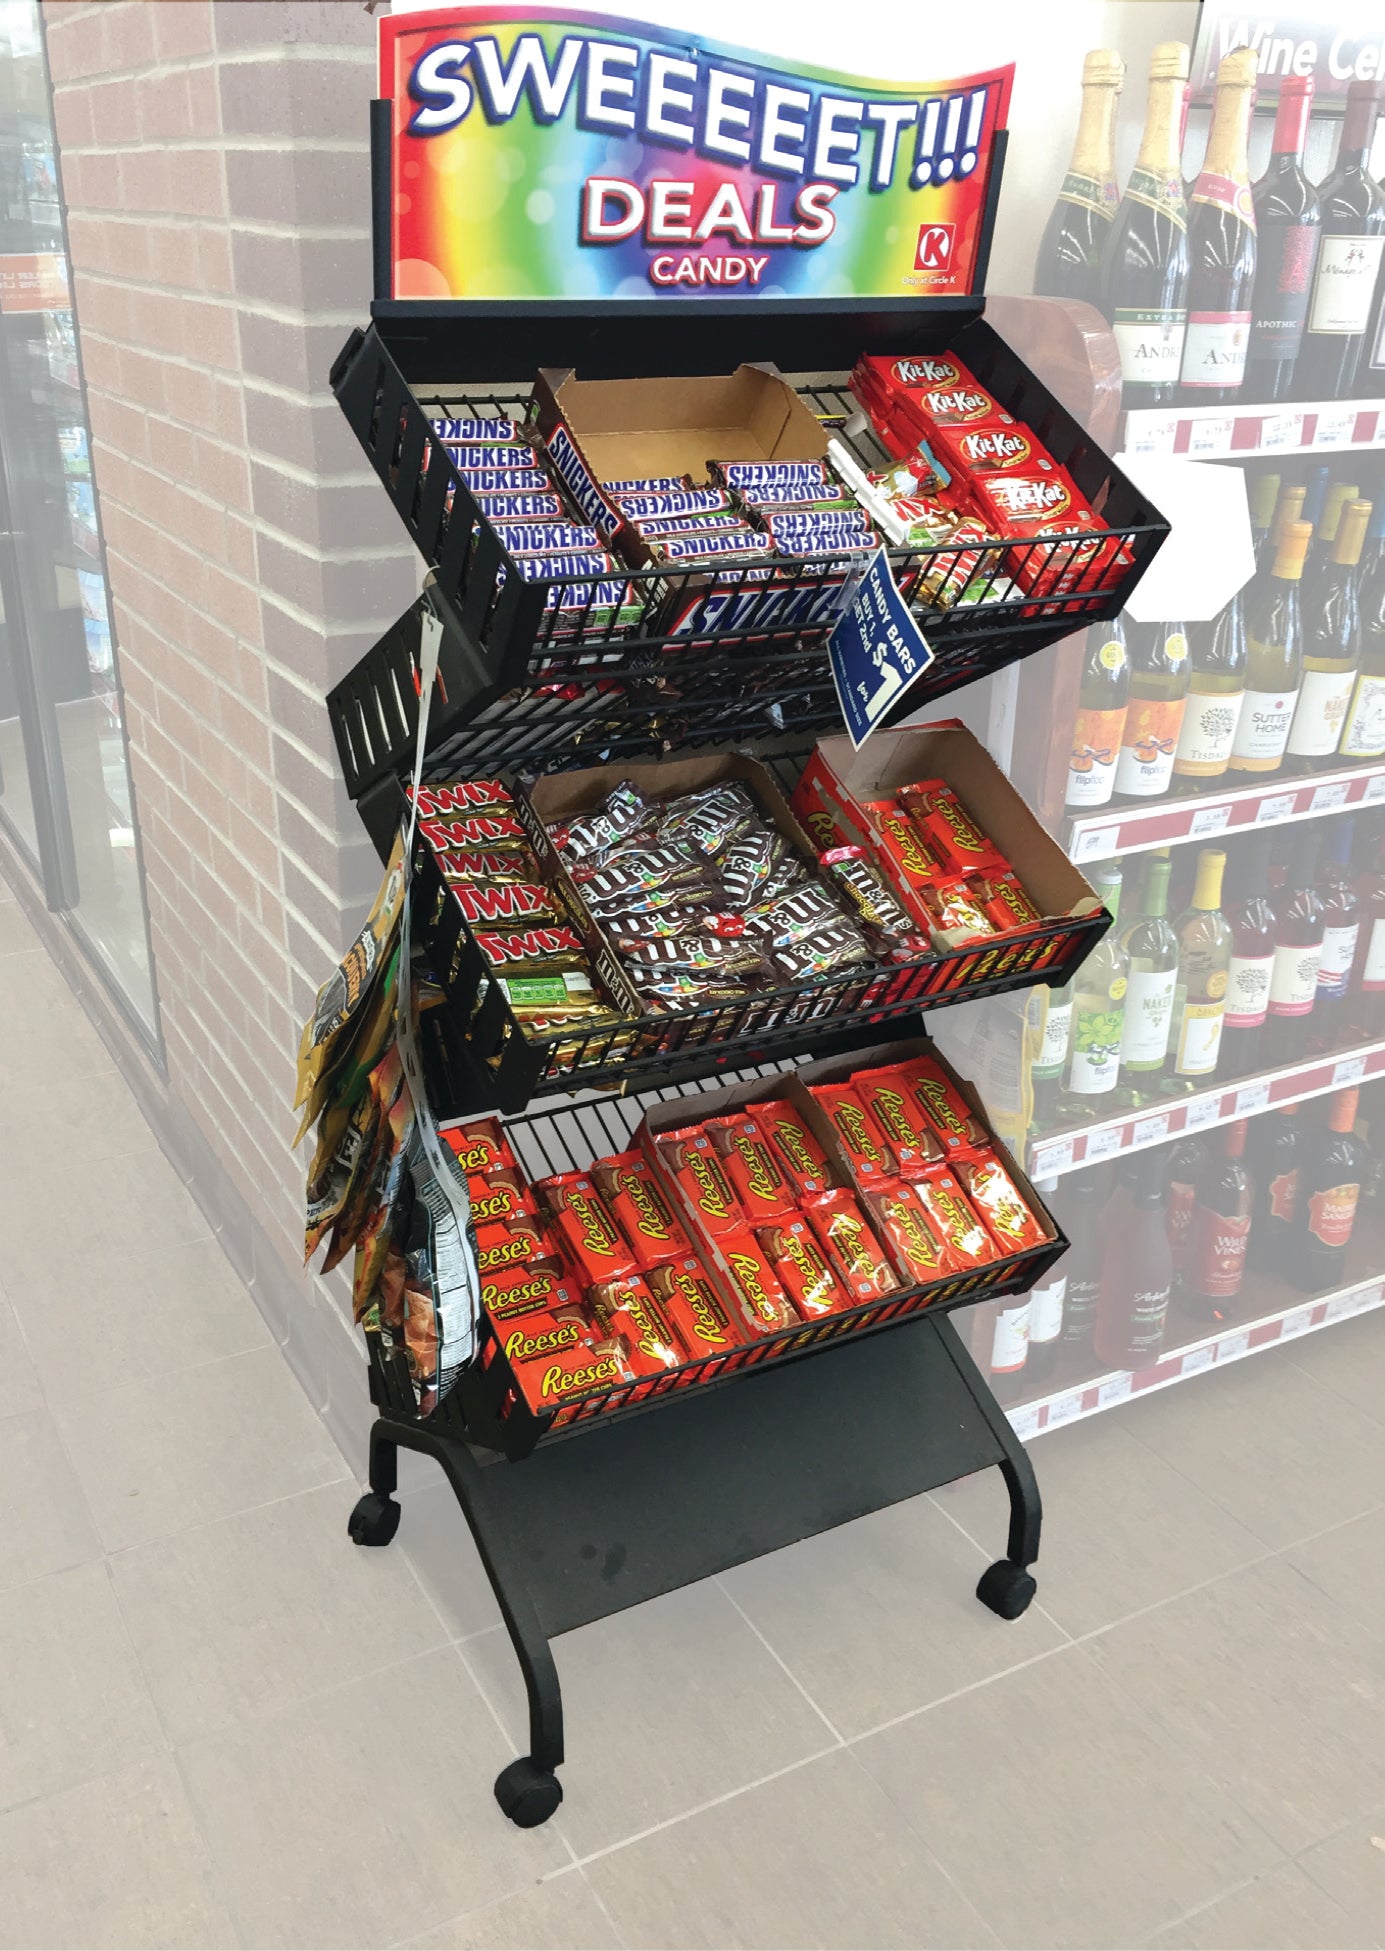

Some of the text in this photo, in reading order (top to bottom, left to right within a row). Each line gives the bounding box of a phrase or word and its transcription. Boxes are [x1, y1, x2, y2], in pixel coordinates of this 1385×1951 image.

[1222, 20, 1318, 77] Wine
[412, 36, 986, 190] SWEEEEET!!!
[583, 178, 837, 245] DEALS
[651, 255, 768, 285] CANDY
[1134, 343, 1180, 359] ANDR
[430, 420, 512, 439] SNICKE
[450, 447, 533, 468] NICKERS
[463, 470, 547, 490] NICKERS
[551, 430, 619, 535] SNICKERS
[602, 478, 682, 491] NICKERS
[728, 464, 822, 487] SNICKERS
[480, 496, 558, 516] ICKERS
[621, 489, 721, 519] SNICKERS
[671, 533, 767, 556] SNICKERS
[517, 553, 606, 579] SNICKE
[549, 581, 629, 608] SNICKE
[861, 592, 875, 621] BUY
[869, 567, 916, 675] CANDY BARS
[859, 624, 873, 654] 2nd
[856, 681, 869, 703] for
[1256, 722, 1286, 733] HOME
[1191, 749, 1227, 760] TISDA
[932, 798, 984, 852] Reese's
[885, 819, 932, 876] Reese's
[994, 883, 1033, 924] ese's
[1143, 995, 1171, 1010] NAKE
[874, 1086, 921, 1148] Reese's
[917, 1078, 968, 1135] Reese's
[836, 1101, 882, 1162] Reese's
[457, 1145, 489, 1170] se's
[775, 1120, 824, 1179] Reese's
[685, 1151, 731, 1218] Reese's
[734, 1136, 779, 1201] Reese's
[470, 1191, 512, 1221] ese's
[621, 1174, 670, 1241] Reese's
[567, 1193, 616, 1256] Reese's
[892, 1202, 938, 1268] Reese's
[478, 1237, 532, 1270] eese's
[481, 1277, 552, 1311] Reese's
[727, 1252, 780, 1322] Reese's
[675, 1273, 728, 1344] Reese's
[505, 1324, 579, 1361] Reese's
[541, 1358, 619, 1398] Reese's
